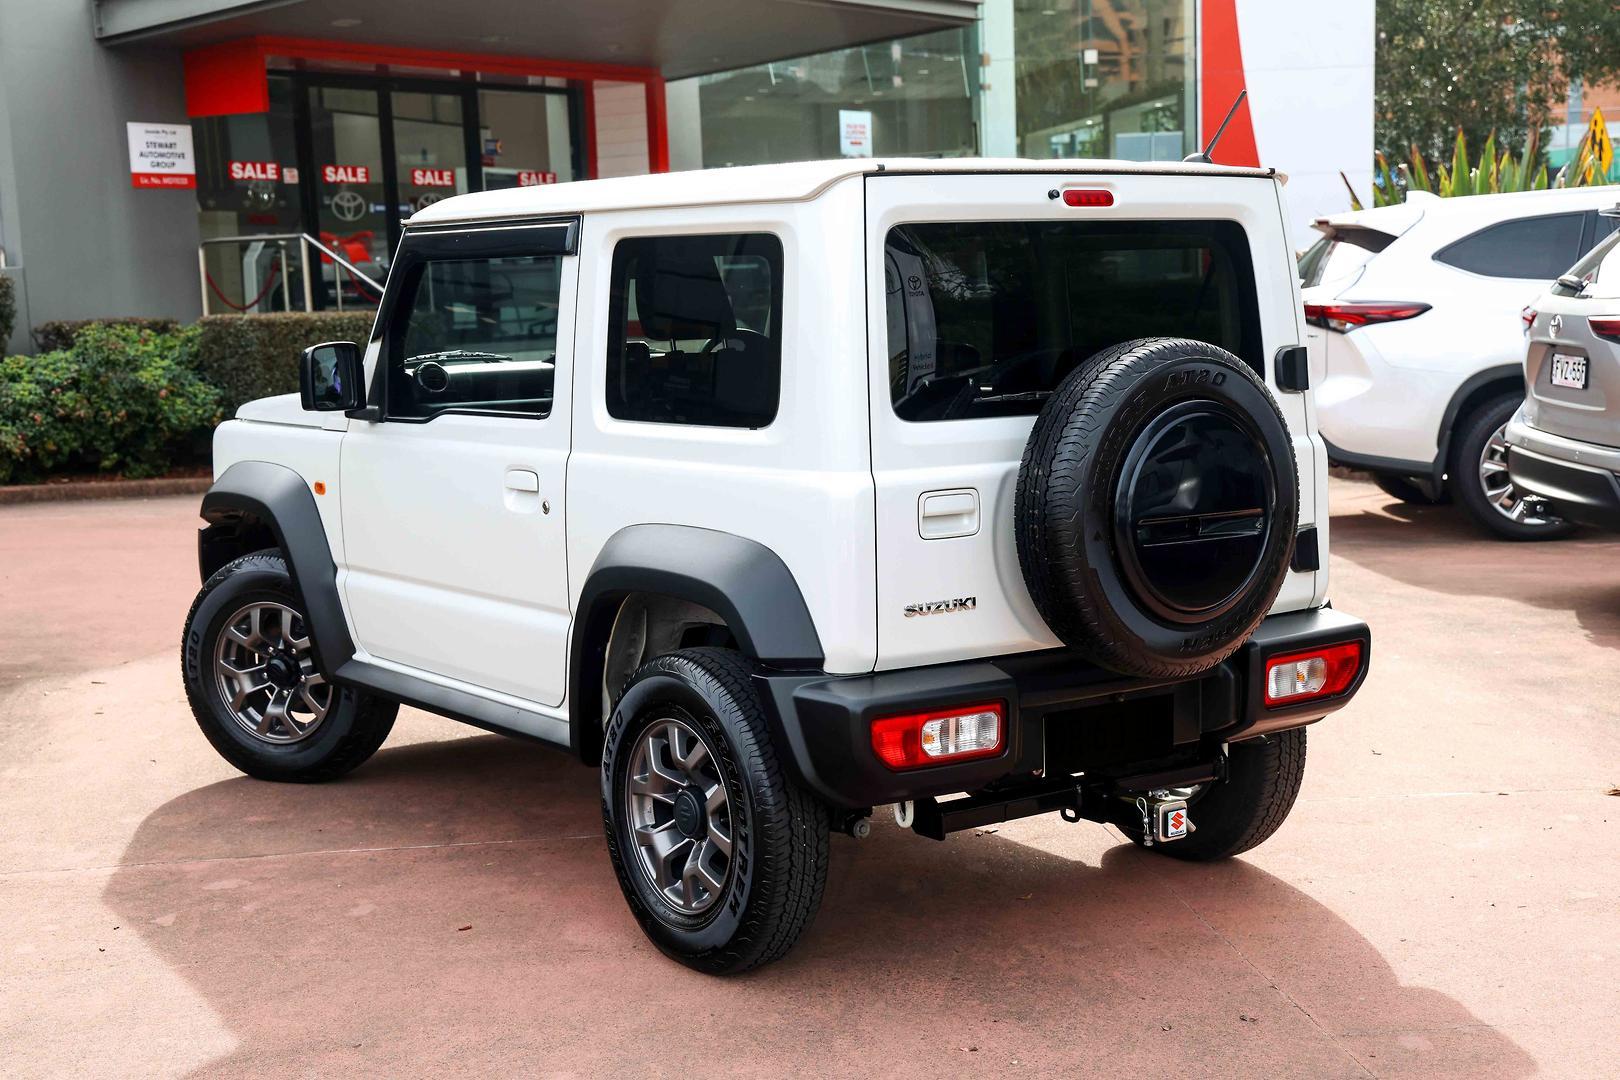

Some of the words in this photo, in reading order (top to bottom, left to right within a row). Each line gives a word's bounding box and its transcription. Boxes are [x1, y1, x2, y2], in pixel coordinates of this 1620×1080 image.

[145, 140, 177, 149] STEWART
[139, 151, 186, 160] AUTOMOTIVE
[150, 160, 177, 169] GROUP
[231, 162, 278, 180] SALE
[325, 166, 368, 182] SALE
[414, 170, 452, 186] SALE
[519, 173, 554, 186] SALE
[903, 596, 977, 618] SUZUKI
[602, 709, 624, 782] AT20
